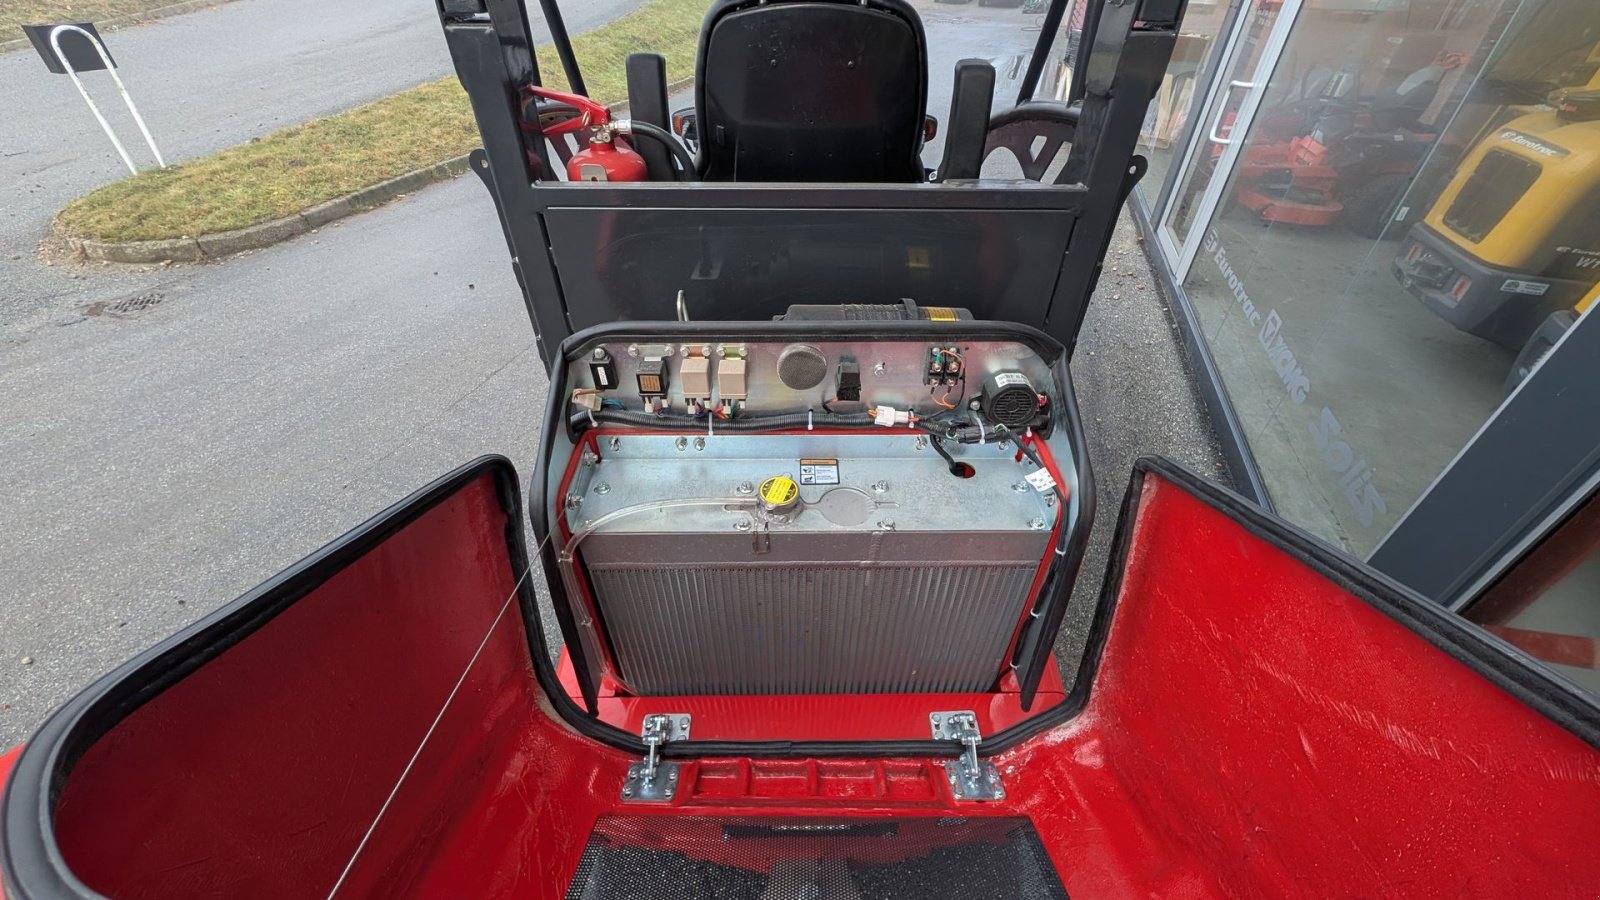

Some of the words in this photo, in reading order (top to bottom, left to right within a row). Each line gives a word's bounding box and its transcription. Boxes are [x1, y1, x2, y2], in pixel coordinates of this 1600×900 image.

[1511, 134, 1557, 156] Eurotrac
[1214, 246, 1261, 328] Eurotrac
[1266, 333, 1311, 405] XCMG
